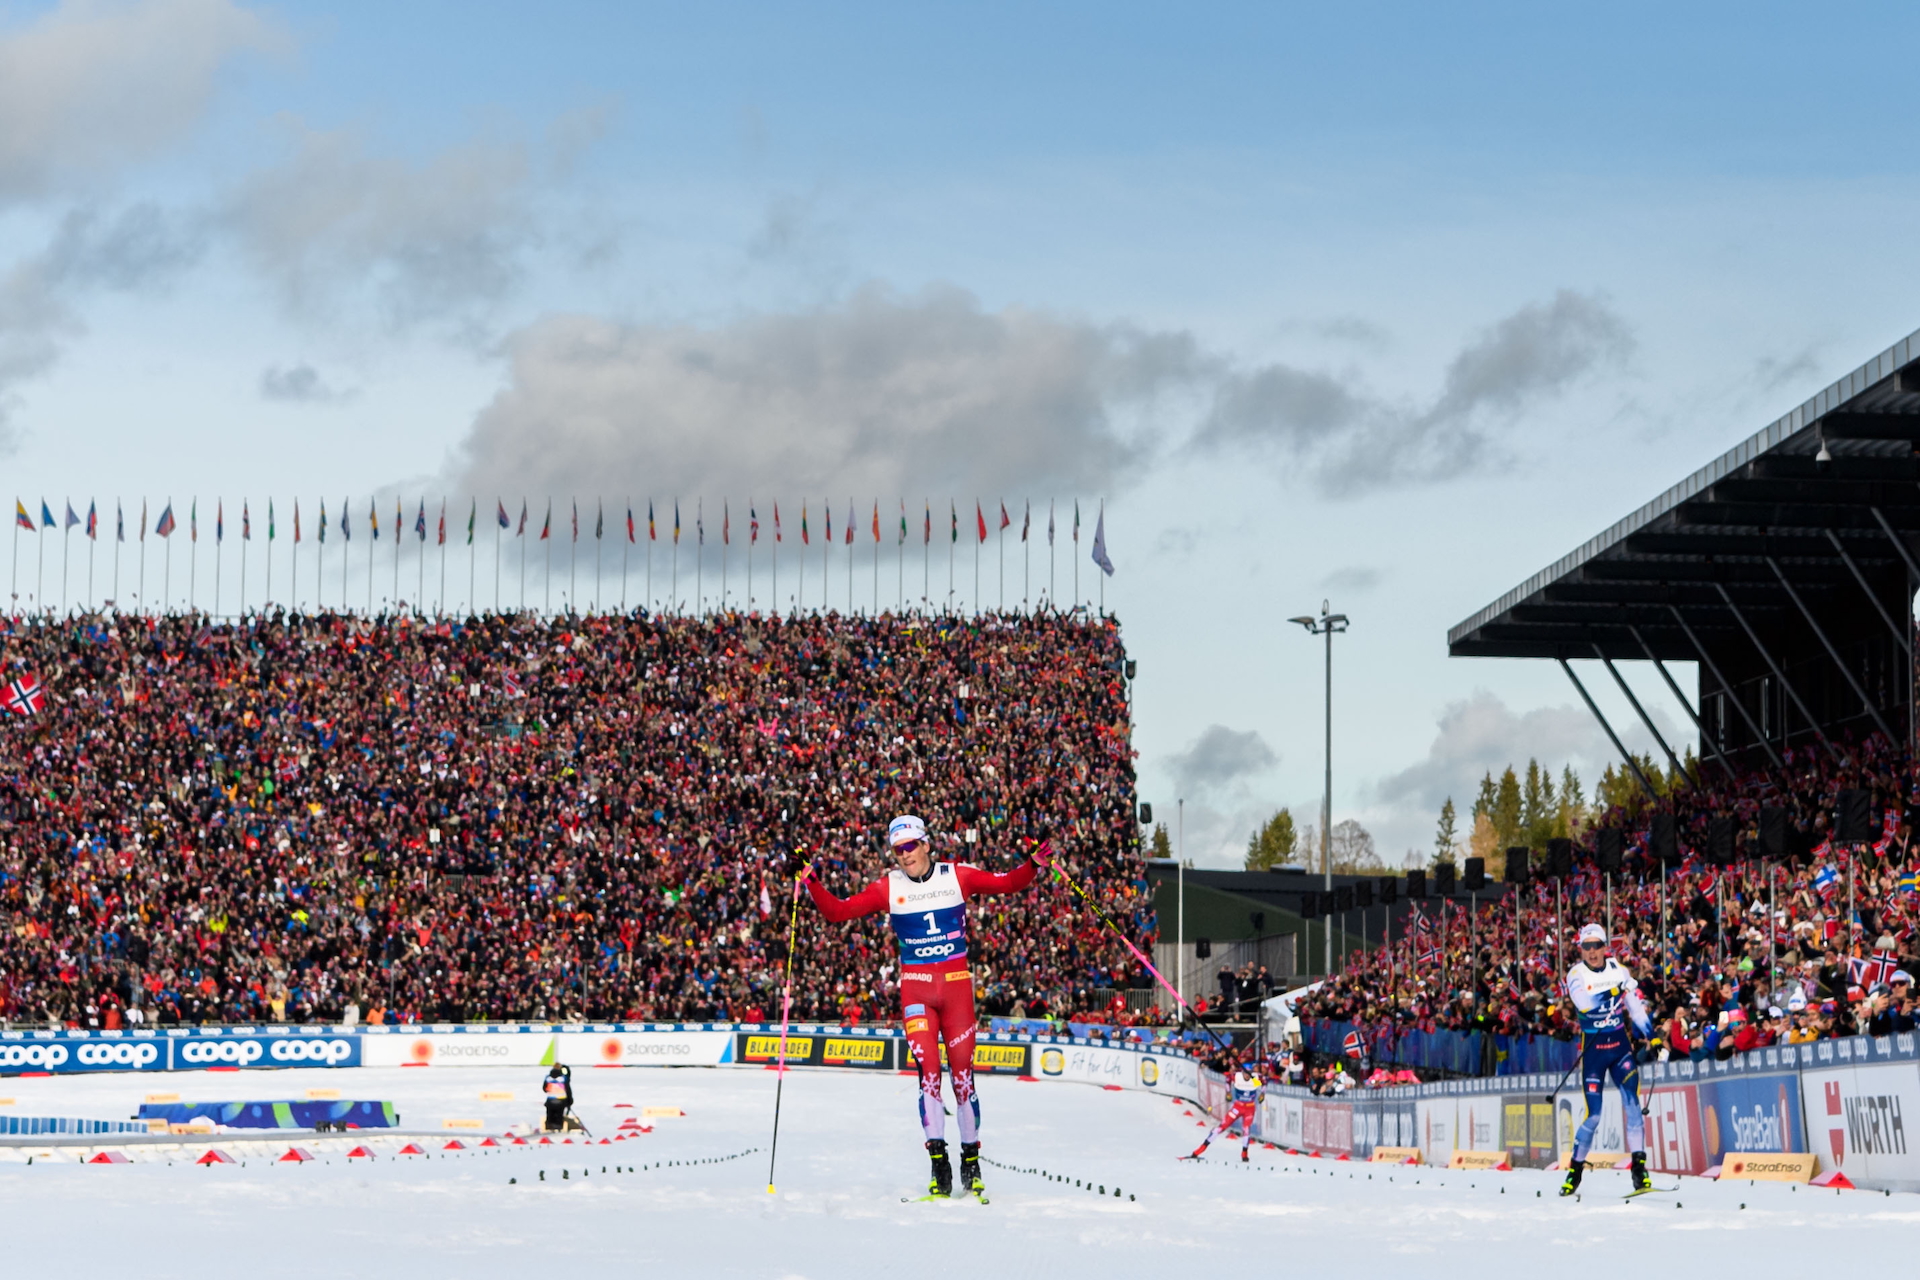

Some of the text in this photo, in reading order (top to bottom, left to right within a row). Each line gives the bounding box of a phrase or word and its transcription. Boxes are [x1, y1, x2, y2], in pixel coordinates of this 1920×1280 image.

[923, 912, 941, 935] 1
[905, 935, 946, 945] TRONDHEIM
[914, 943, 955, 957] coop
[77, 1043, 158, 1068] coop
[182, 1040, 351, 1066] coop coop
[1731, 1103, 1782, 1153] SpareBank
[1844, 1095, 1907, 1155] WÜRTH
[1746, 1162, 1802, 1173] StoraEnso
